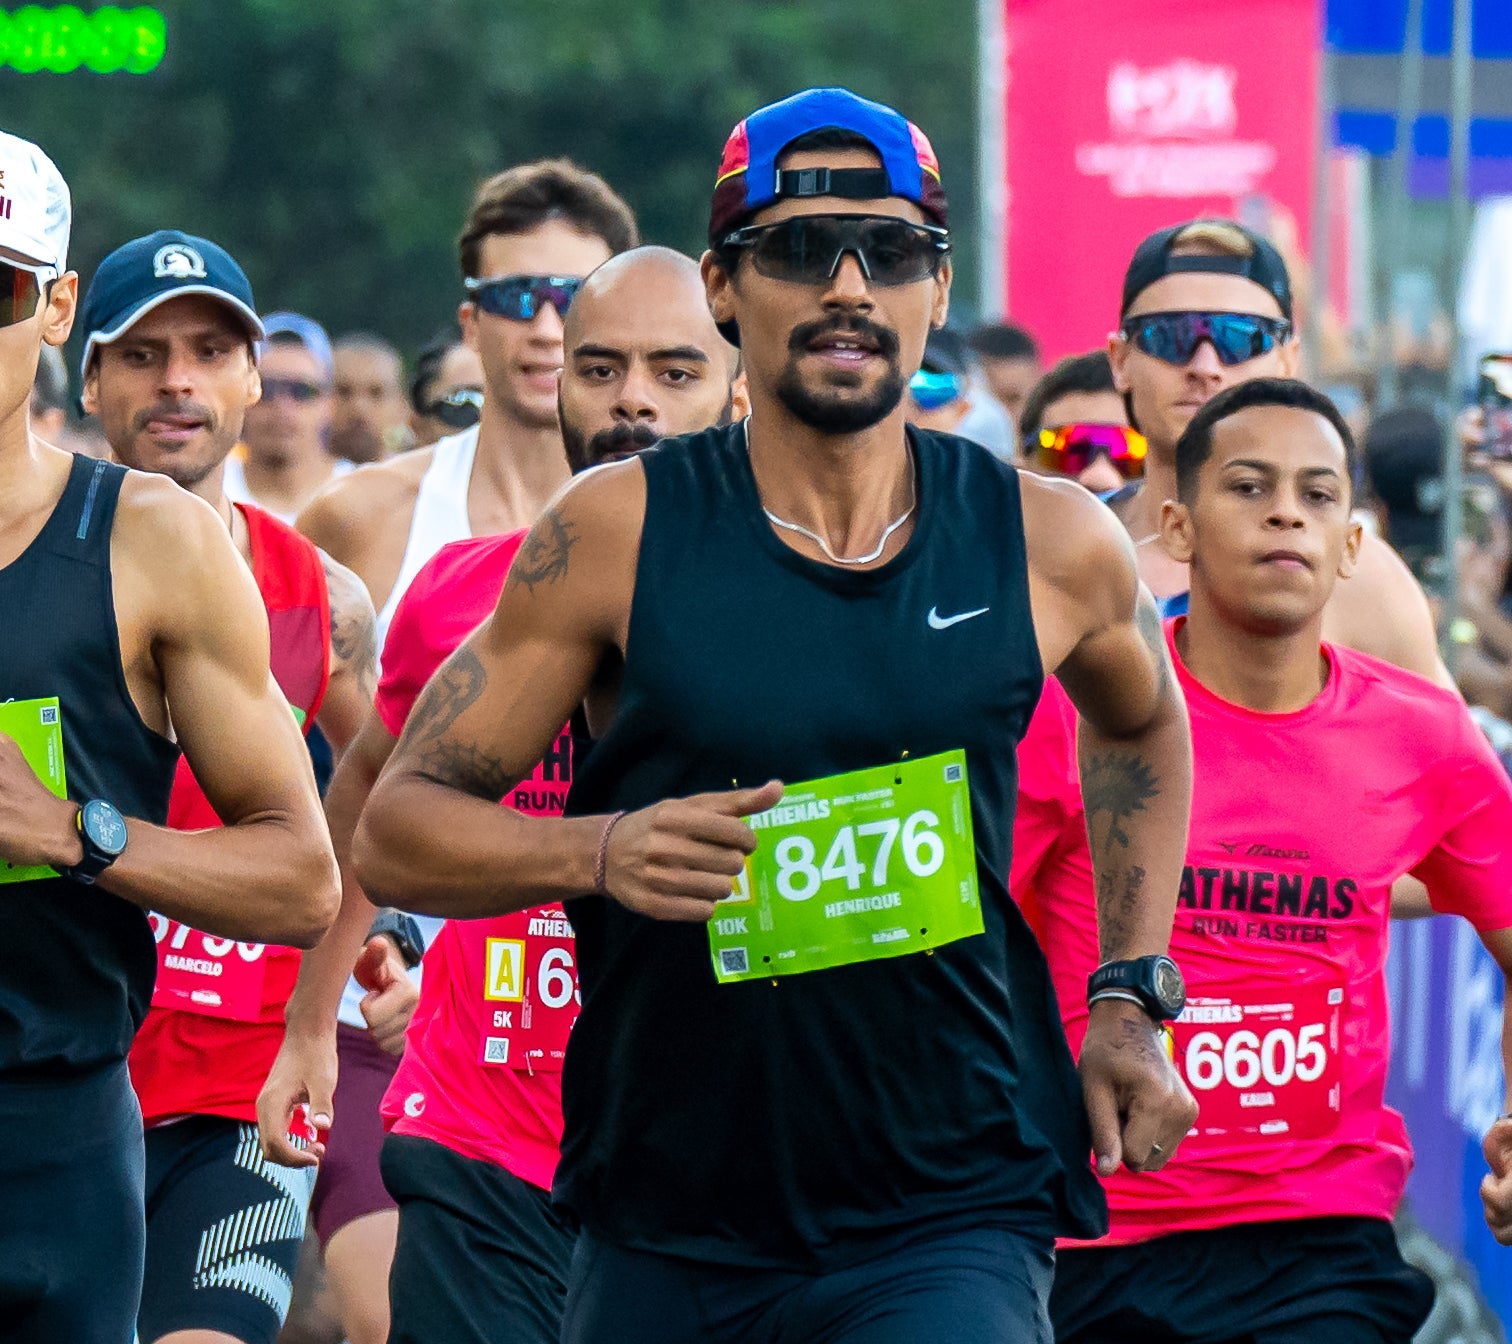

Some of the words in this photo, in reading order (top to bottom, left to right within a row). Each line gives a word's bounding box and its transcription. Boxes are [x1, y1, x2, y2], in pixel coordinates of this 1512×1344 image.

[513, 790, 566, 813] RUN
[749, 799, 832, 831] ATHENAS
[774, 809, 945, 903] 8476
[824, 892, 902, 919] HENRIQUE
[1177, 866, 1358, 920] ATHENAS
[714, 916, 748, 937] 10K
[1245, 921, 1328, 944] FASTER
[494, 947, 515, 993] A
[493, 1010, 513, 1029] 5K
[1185, 1023, 1327, 1090] 6605
